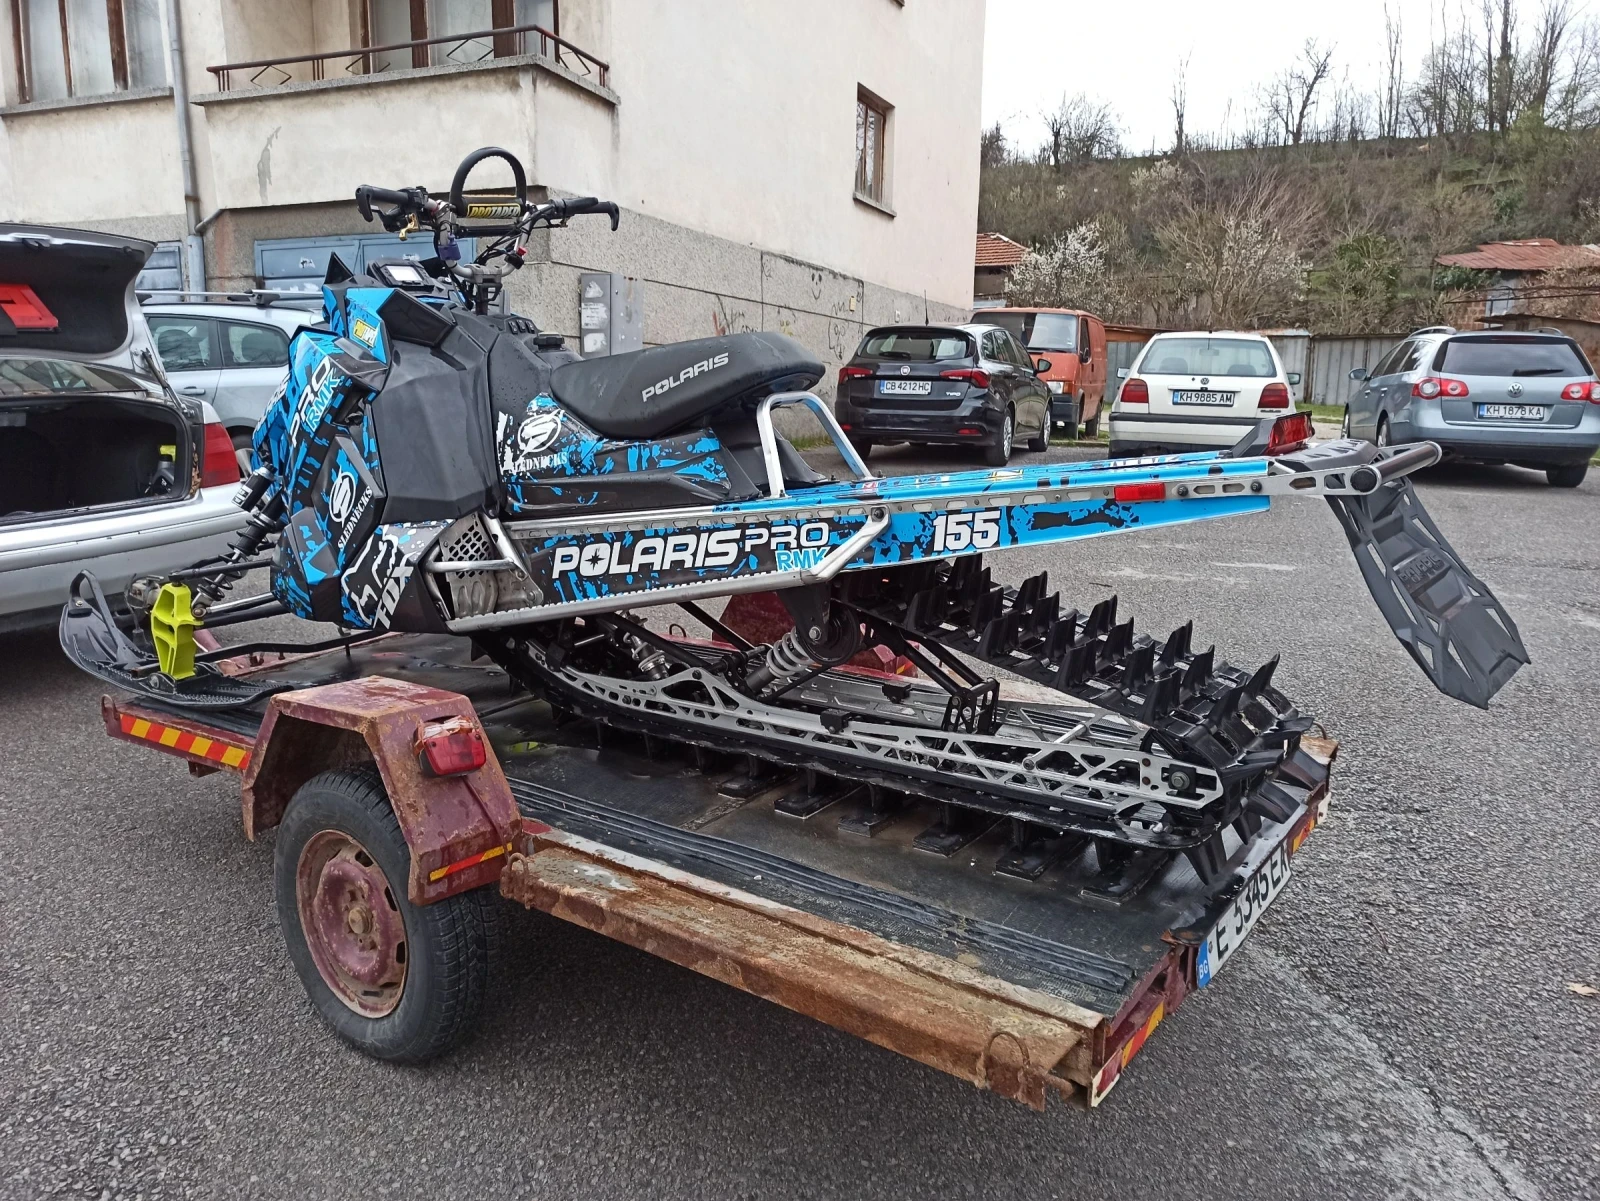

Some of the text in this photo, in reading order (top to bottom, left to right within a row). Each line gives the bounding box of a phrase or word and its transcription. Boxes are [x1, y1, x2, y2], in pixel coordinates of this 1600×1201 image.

[641, 352, 729, 403] POLARIS
[885, 382, 930, 392] CB 4212 HC
[1179, 392, 1233, 403] KH 9885 AM
[290, 356, 330, 448] PRO
[306, 367, 341, 432] RMK
[1486, 405, 1542, 417] KH 1878 KA
[337, 485, 373, 549] SLEDNECKS
[933, 510, 1001, 552] 155
[552, 522, 829, 579] POLARIS PRO
[775, 547, 831, 572] RMK
[373, 551, 416, 629] FOX
[1215, 922, 1229, 961] E
[1199, 959, 1209, 980] BG
